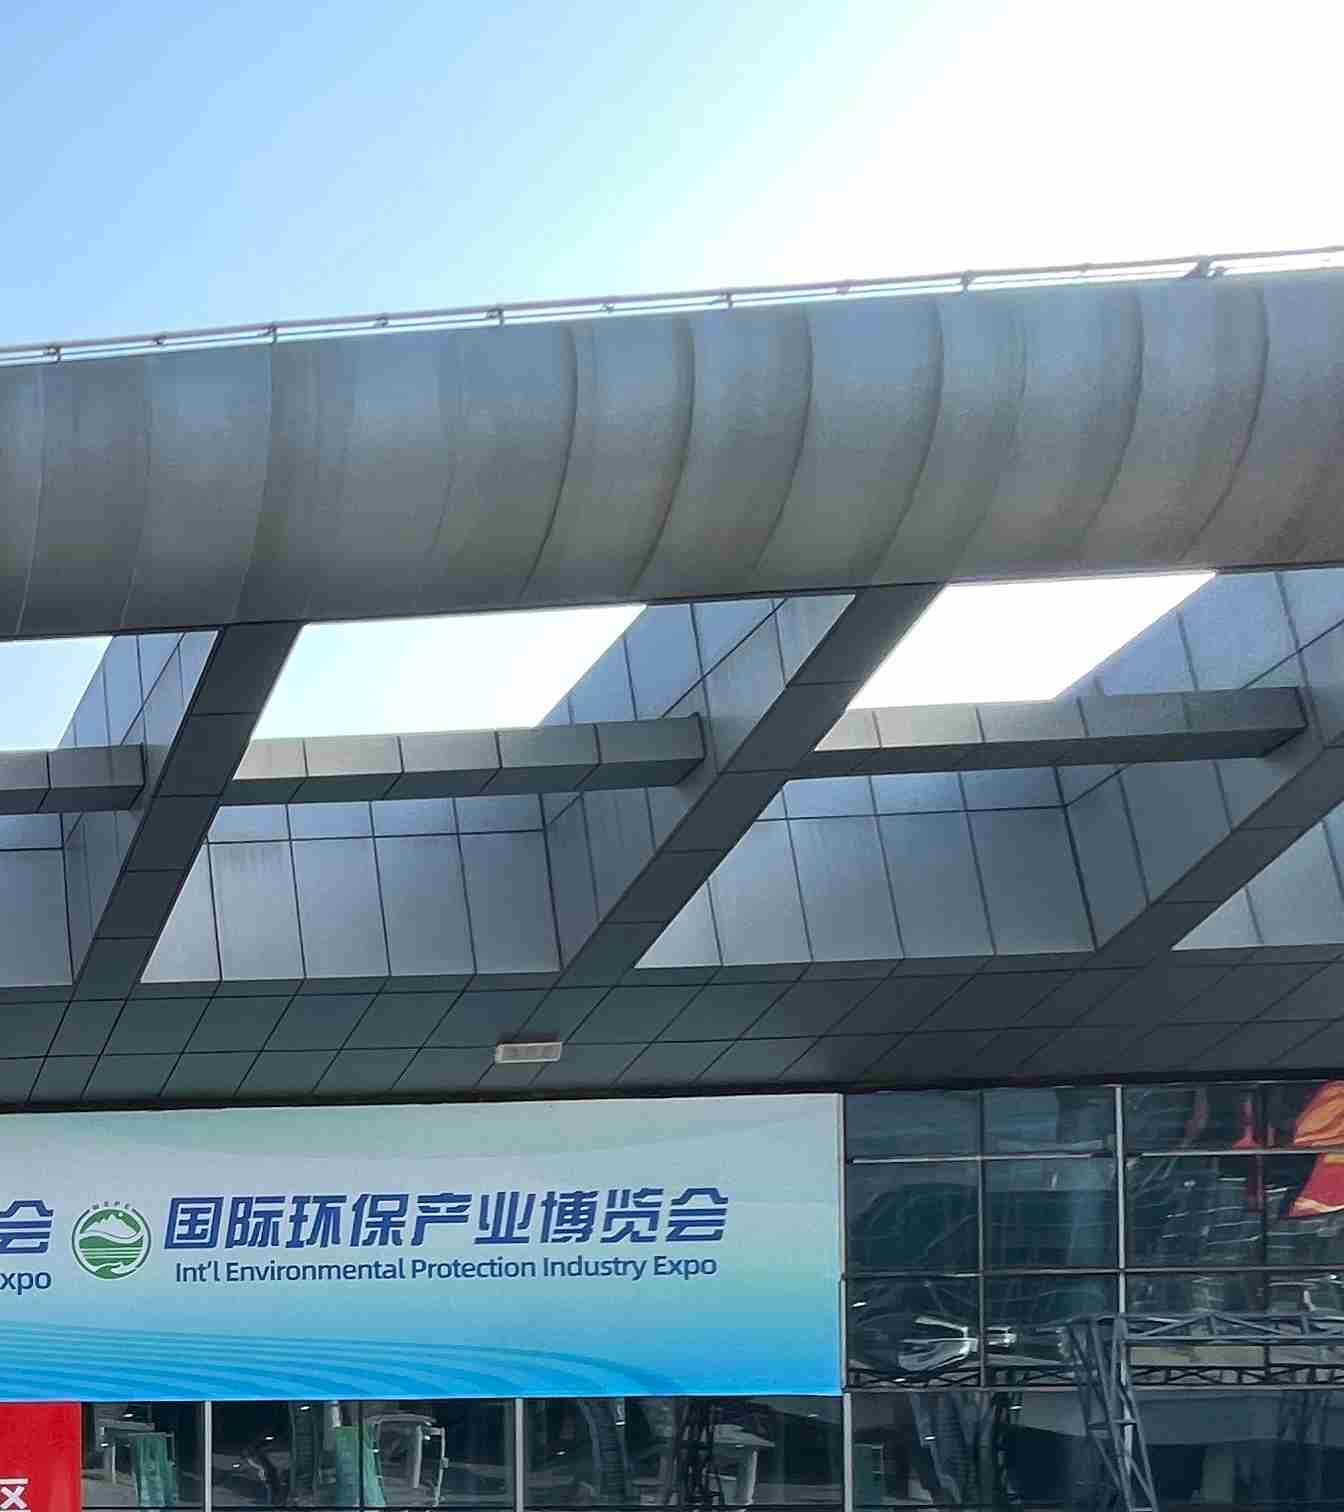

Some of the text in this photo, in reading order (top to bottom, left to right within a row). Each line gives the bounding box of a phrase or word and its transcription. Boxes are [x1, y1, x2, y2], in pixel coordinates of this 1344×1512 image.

[163, 1186, 729, 1250] 国际环保产业博览会
[226, 1257, 406, 1282] Environmental
[411, 1256, 536, 1279] Protection
[543, 1254, 648, 1281] Industry
[653, 1255, 717, 1281] Expo
